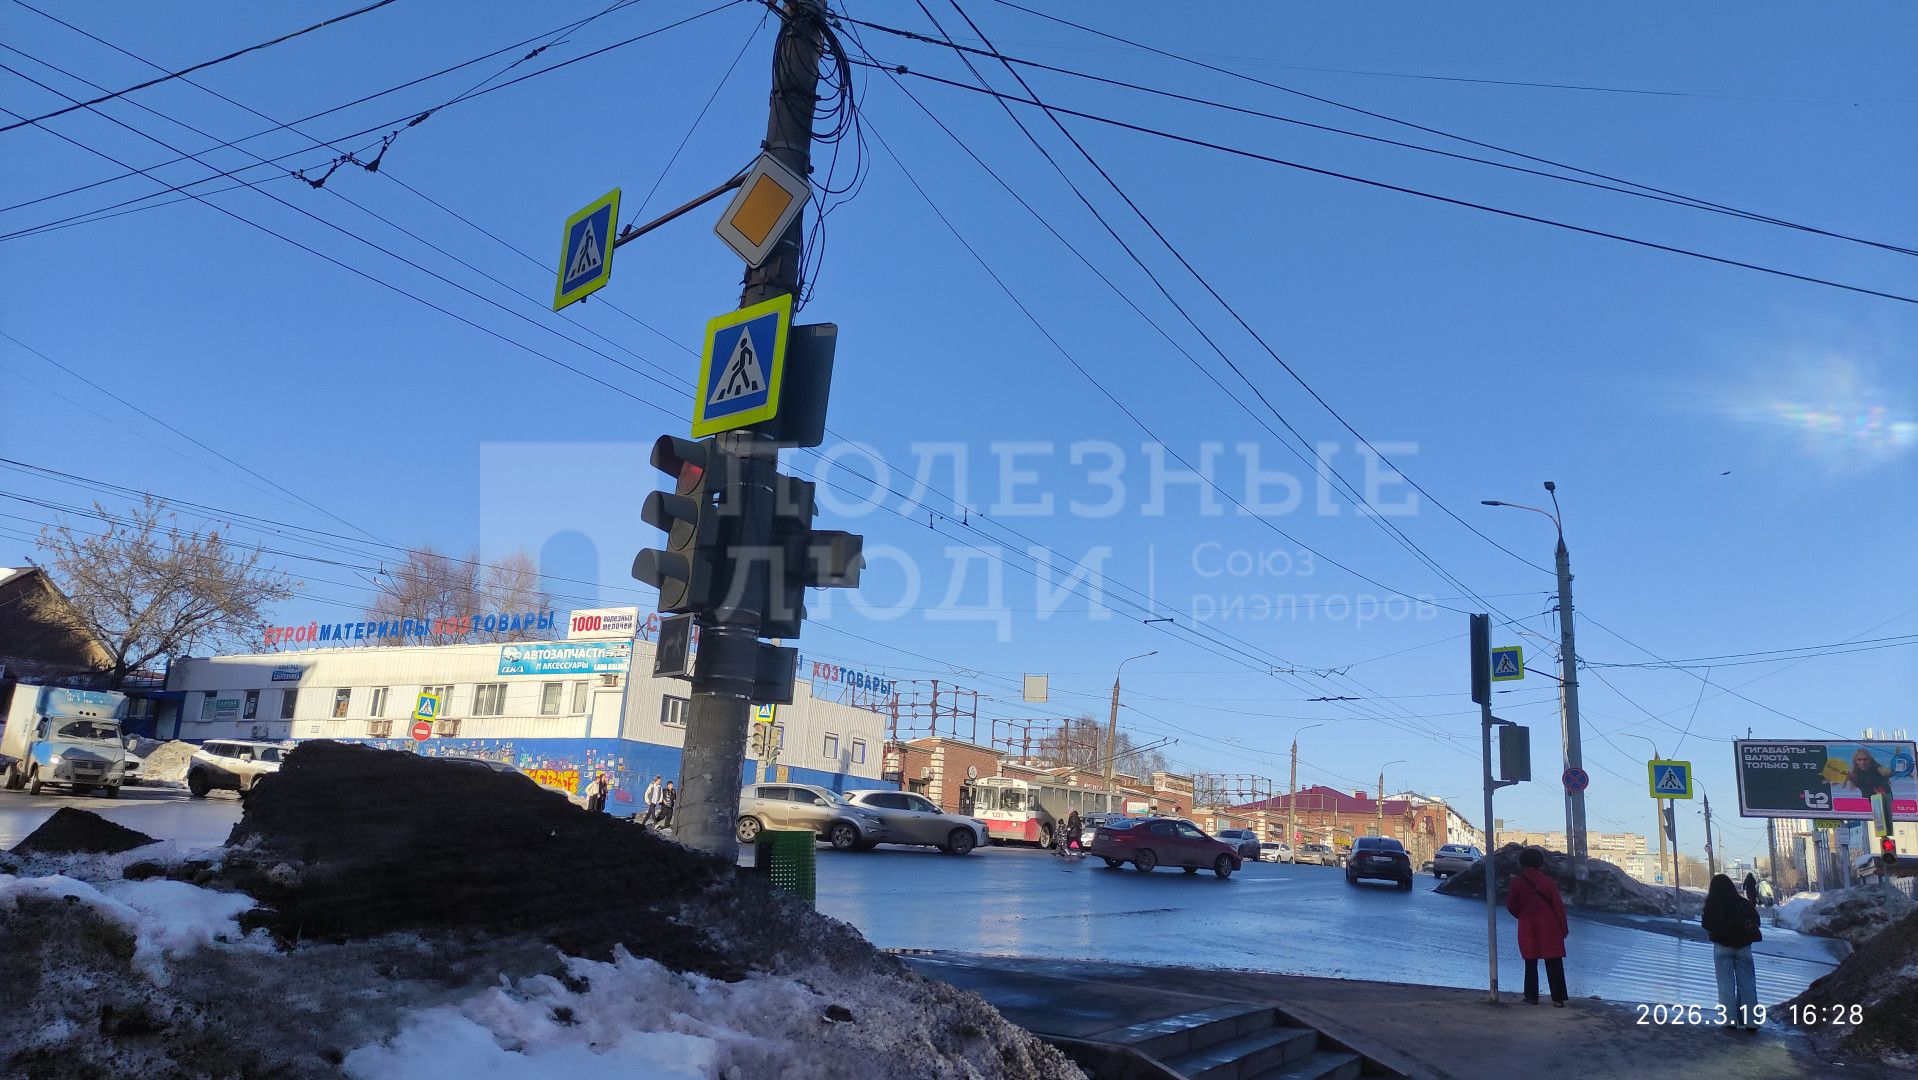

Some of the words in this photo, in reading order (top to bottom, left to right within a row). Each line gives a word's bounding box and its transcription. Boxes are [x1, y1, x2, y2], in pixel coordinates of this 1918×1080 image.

[572, 616, 601, 632] 1000
[523, 648, 606, 660] АВТОЗАПЧАСТИ
[1744, 746, 1806, 754] ГИГАБАЙТЫ
